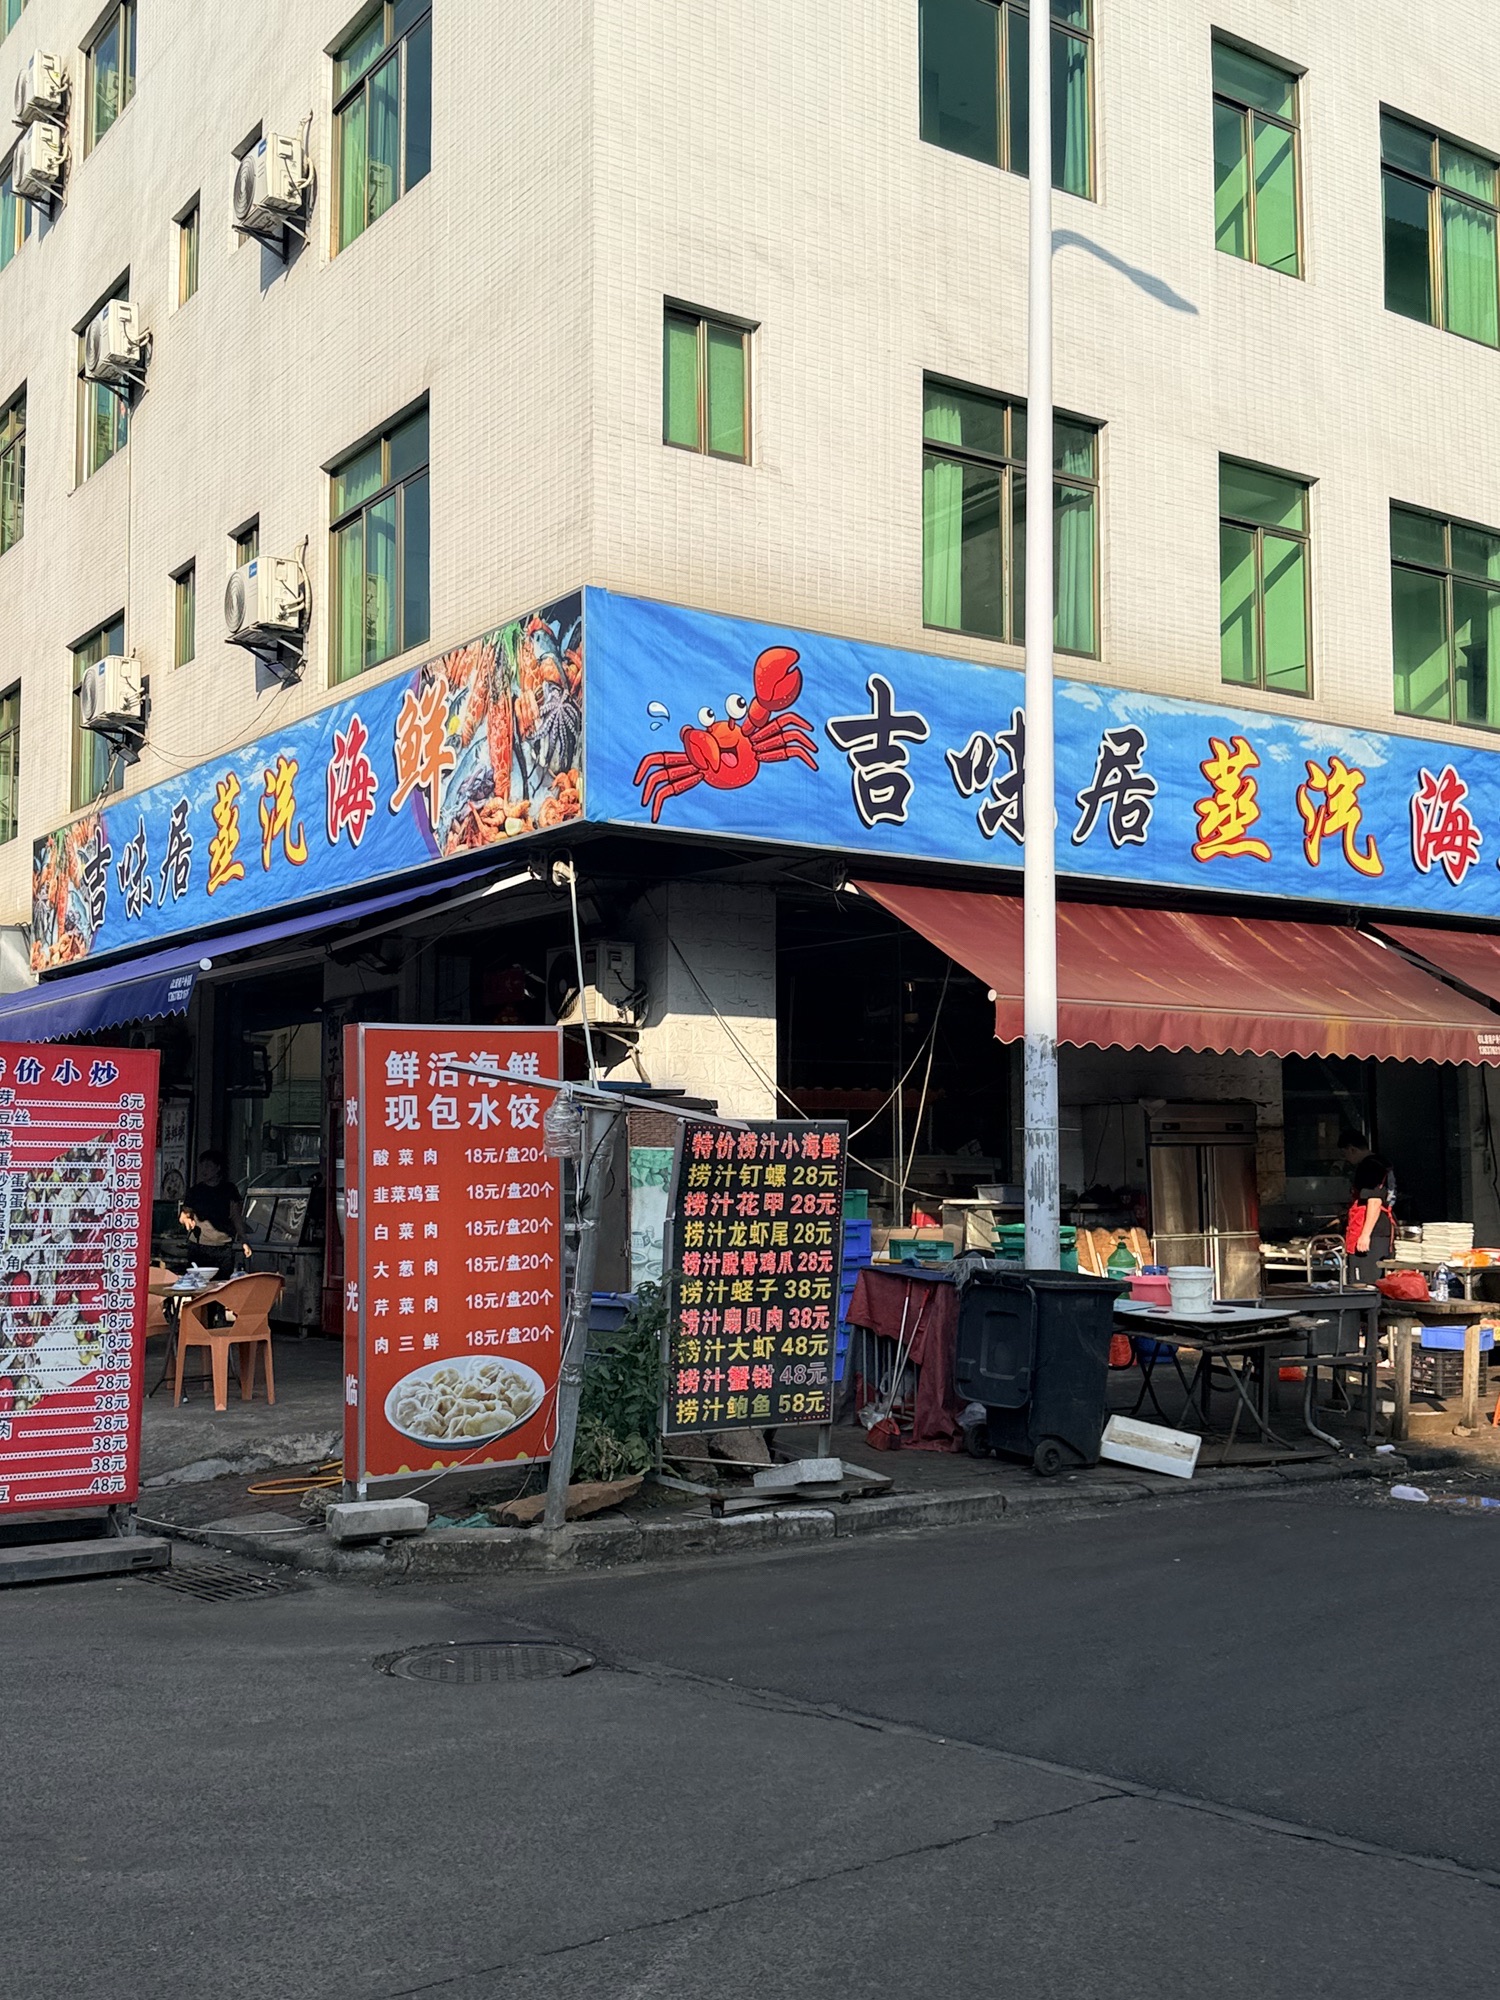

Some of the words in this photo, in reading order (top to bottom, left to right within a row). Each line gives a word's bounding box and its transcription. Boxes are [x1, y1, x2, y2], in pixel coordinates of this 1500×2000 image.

[82, 675, 455, 930] 吉味居蒸汽海鲜
[385, 1051, 539, 1087] 鲜活海鲜
[121, 1095, 144, 1109] 8元
[385, 1094, 540, 1131] 现包水饺
[120, 1116, 143, 1129] 8元
[119, 1135, 142, 1148] 8元
[692, 1131, 840, 1159] 特价捞汁小海鲜
[110, 1154, 141, 1168] 18元
[373, 1148, 438, 1166] 酸菜肉
[108, 1175, 140, 1189] 18元
[688, 1163, 786, 1187] 捞汁钉螺
[792, 1165, 838, 1187] 28元
[373, 1185, 440, 1203] 韭菜鸡蛋
[467, 1181, 554, 1199] 18元/盘20个
[108, 1195, 139, 1209] 18元
[684, 1191, 783, 1216] 捞汁花甲
[790, 1193, 836, 1215] 28元
[106, 1215, 138, 1228] 18元
[374, 1222, 438, 1240] 白菜肉
[466, 1217, 553, 1236] 18元/盘20个
[105, 1235, 137, 1248] 18元
[684, 1220, 788, 1247] 捞汁龙虾尾
[793, 1221, 832, 1245] 28元
[346, 1096, 359, 1407] 欢迎光临
[0, 1256, 20, 1271] 角
[103, 1255, 136, 1268] 18元
[373, 1259, 438, 1278] 大葱肉
[466, 1253, 553, 1272] 18元/盘20个
[682, 1250, 793, 1276] 捞汁脱骨鸡爪
[797, 1250, 833, 1273] 28元
[102, 1274, 135, 1288] 18元
[680, 1278, 778, 1304] 捞汁蛏子
[784, 1277, 831, 1300] 38元
[102, 1294, 134, 1308] 18元
[374, 1296, 438, 1316] 芹菜肉
[466, 1289, 553, 1309] 18元/盘20个
[100, 1315, 133, 1328] 18元
[680, 1306, 783, 1336] 捞汁扇贝肉
[788, 1305, 829, 1330] 38元
[100, 1335, 132, 1349] 18元
[374, 1333, 439, 1354] 肉三鲜
[466, 1325, 554, 1345] 18元/盘20个
[678, 1335, 776, 1364] 捞汁大虾
[781, 1334, 828, 1357] 48元
[99, 1355, 131, 1369] 18元
[97, 1375, 130, 1390] 28元
[676, 1364, 774, 1395] 捞汁蟹钳
[780, 1362, 827, 1385] 48元
[96, 1395, 129, 1410] 28元
[676, 1394, 771, 1424] 捞汁鲍鱼
[779, 1391, 825, 1414] 58元
[94, 1416, 128, 1431] 28元
[93, 1436, 127, 1451] 38元
[92, 1457, 126, 1472] 38元
[91, 1477, 125, 1492] 48元
